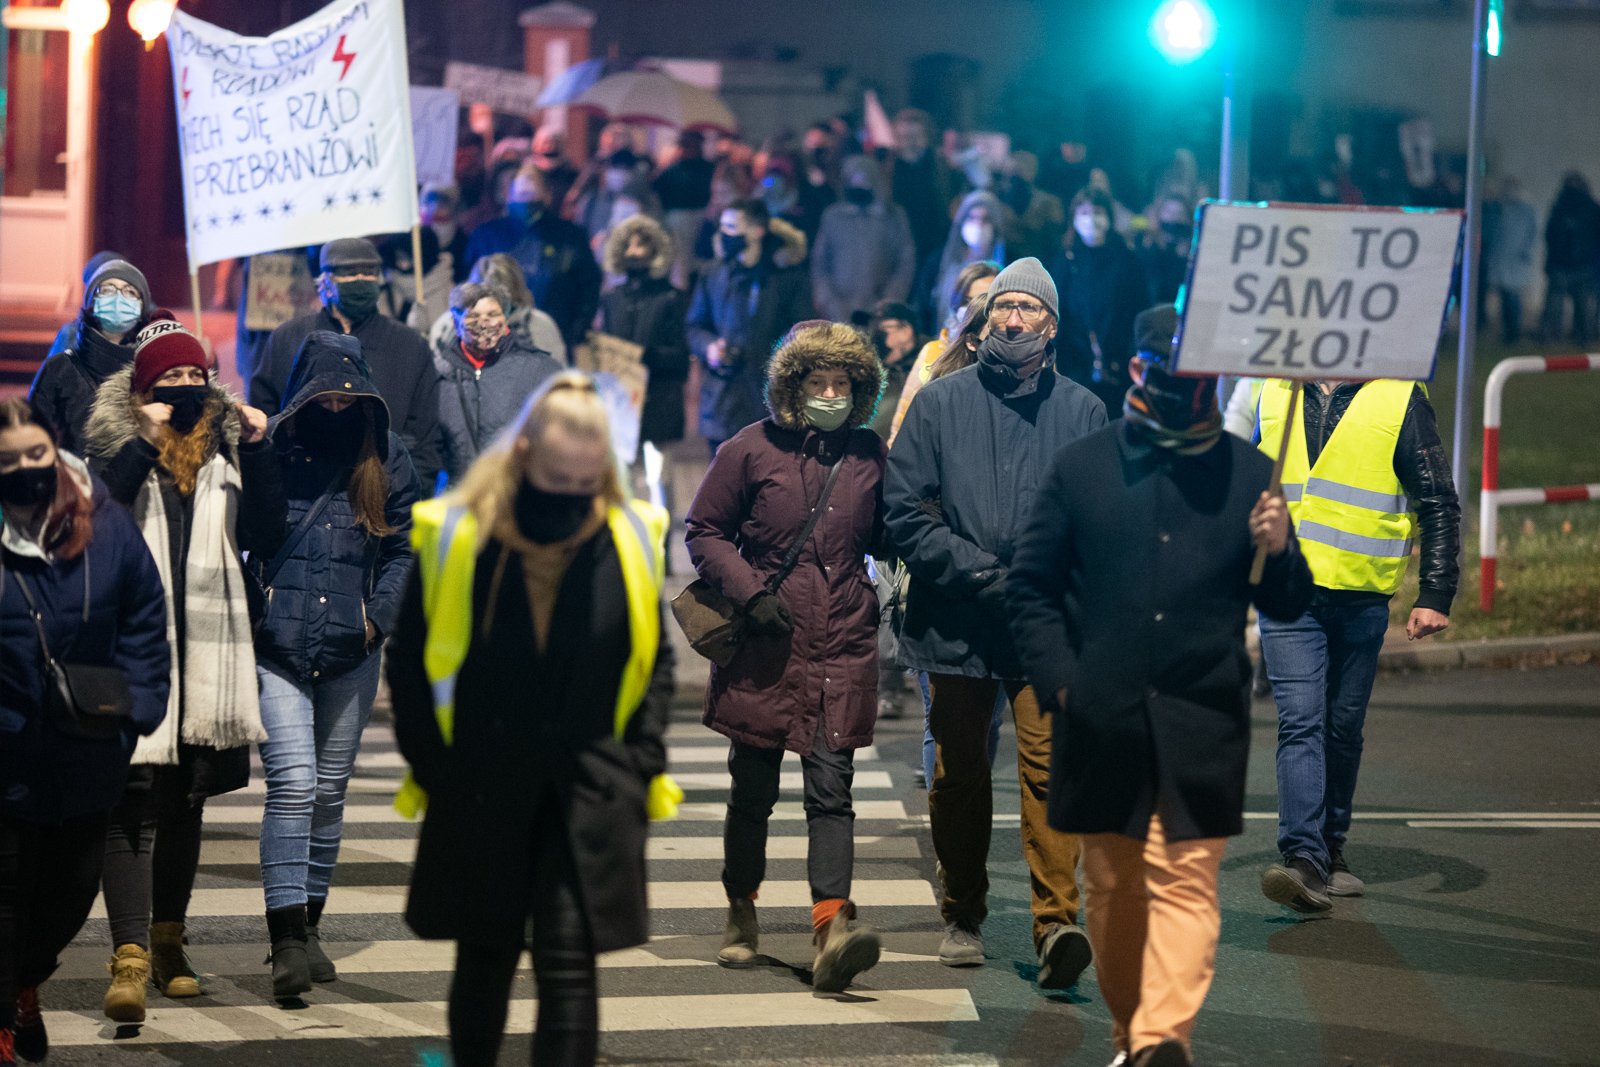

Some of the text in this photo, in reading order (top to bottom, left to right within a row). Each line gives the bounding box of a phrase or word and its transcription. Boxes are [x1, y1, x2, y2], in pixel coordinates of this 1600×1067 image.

[232, 101, 272, 144] SIĘ
[287, 87, 360, 132] RZĄD
[194, 122, 380, 198] PRZEBRANŻOWI
[1230, 223, 1420, 270] PIS TO
[1228, 272, 1399, 322] SAMO
[1248, 327, 1371, 369] ZŁO!
